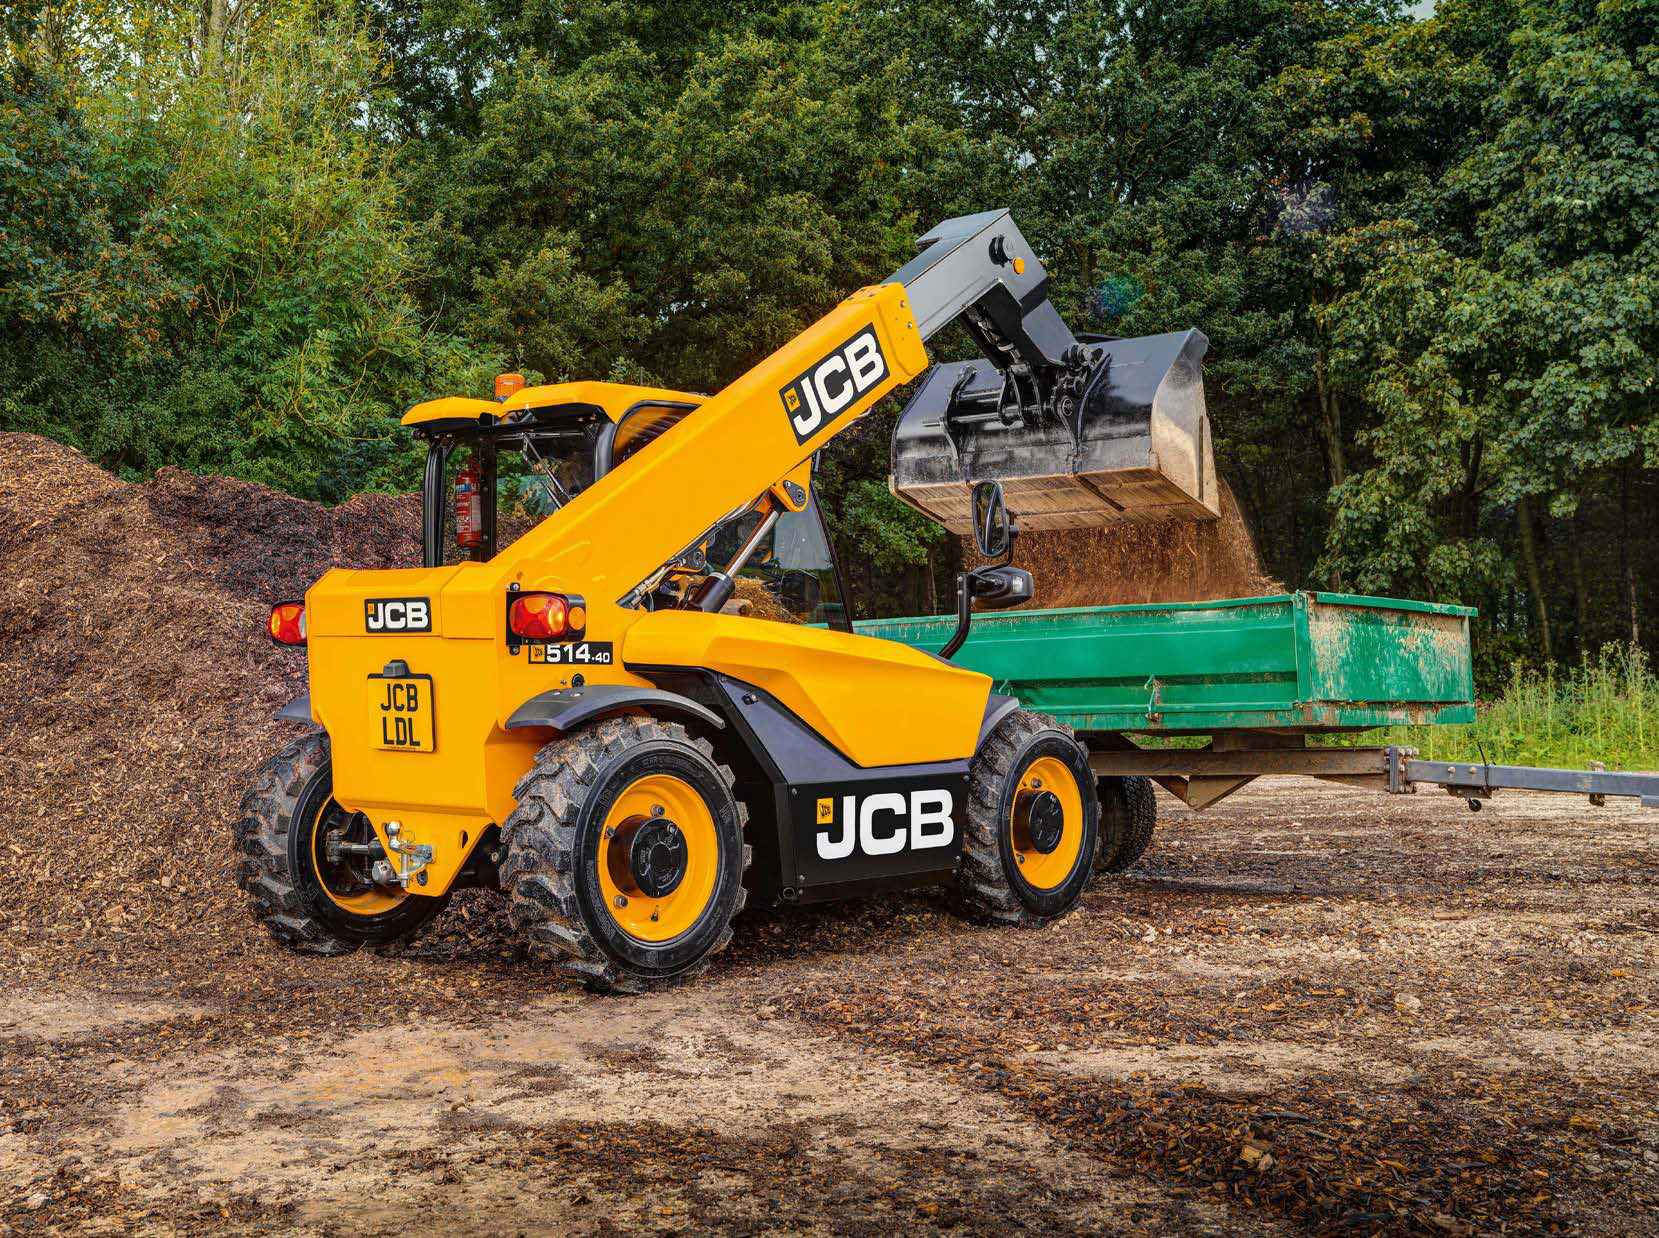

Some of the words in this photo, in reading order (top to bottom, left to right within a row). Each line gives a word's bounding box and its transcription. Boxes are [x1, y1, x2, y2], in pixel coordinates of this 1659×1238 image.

[793, 332, 885, 436] JCB
[368, 601, 429, 629] JCB
[380, 683, 419, 712] JCB
[382, 716, 421, 747] LDL
[816, 788, 955, 860] JCB
